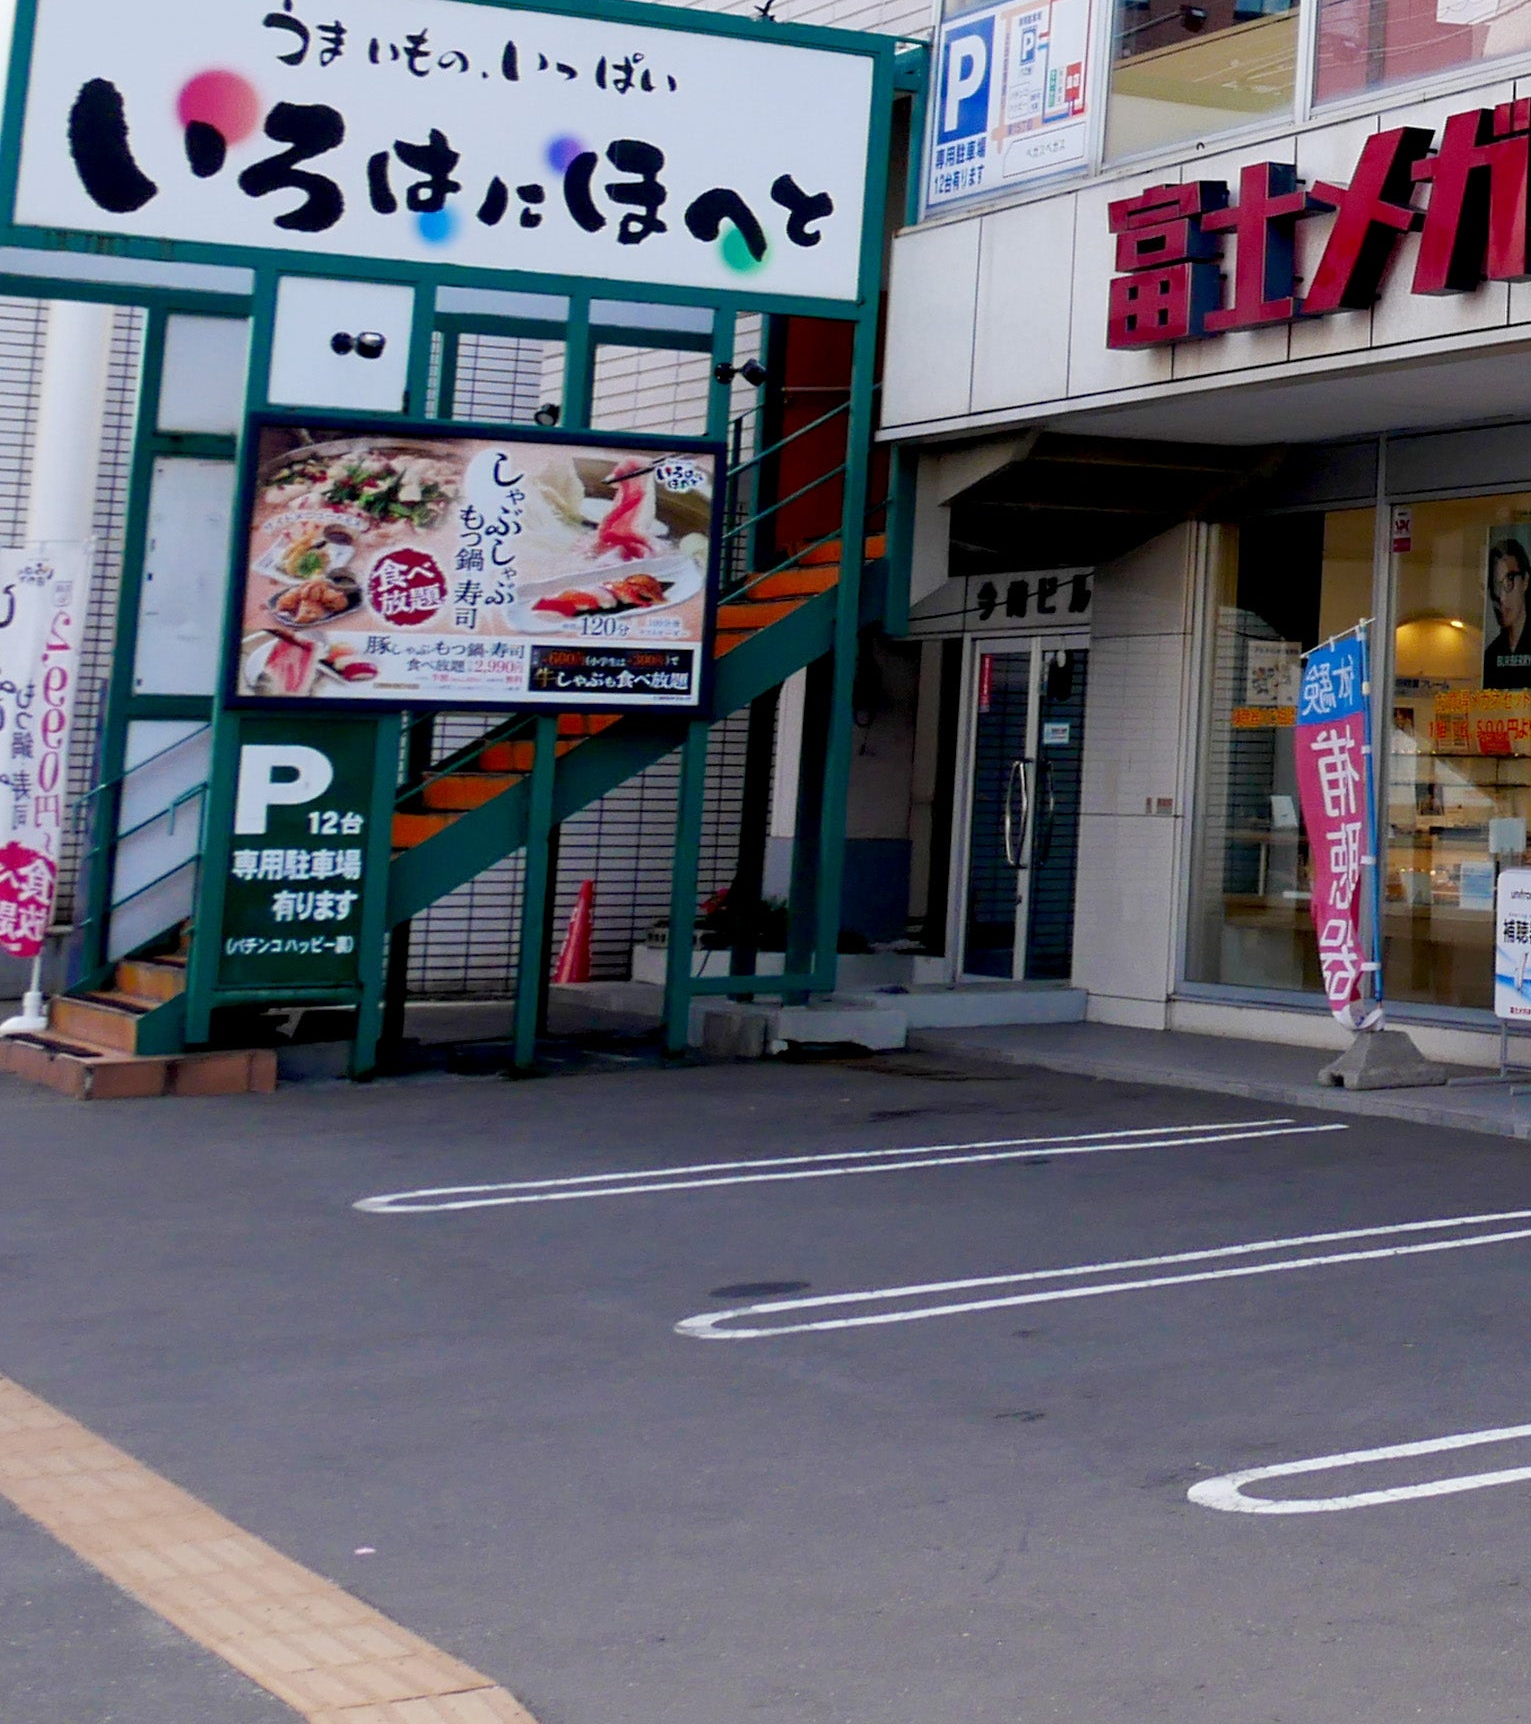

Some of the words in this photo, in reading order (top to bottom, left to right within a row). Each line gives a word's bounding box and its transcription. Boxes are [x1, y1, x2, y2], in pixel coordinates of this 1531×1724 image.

[945, 34, 987, 133] P
[67, 76, 835, 263] いろはにほへと
[935, 137, 987, 170] 専用駐車場
[455, 504, 486, 573] もつ鍋
[484, 452, 526, 606] しゃぶしゃぶ
[373, 558, 436, 593] 食べ
[377, 583, 446, 616] 放題
[453, 579, 484, 631] 寿司
[233, 744, 334, 835] P
[307, 810, 364, 835] 12台
[232, 848, 363, 881] 専用駐車場
[271, 888, 359, 922] 有ります
